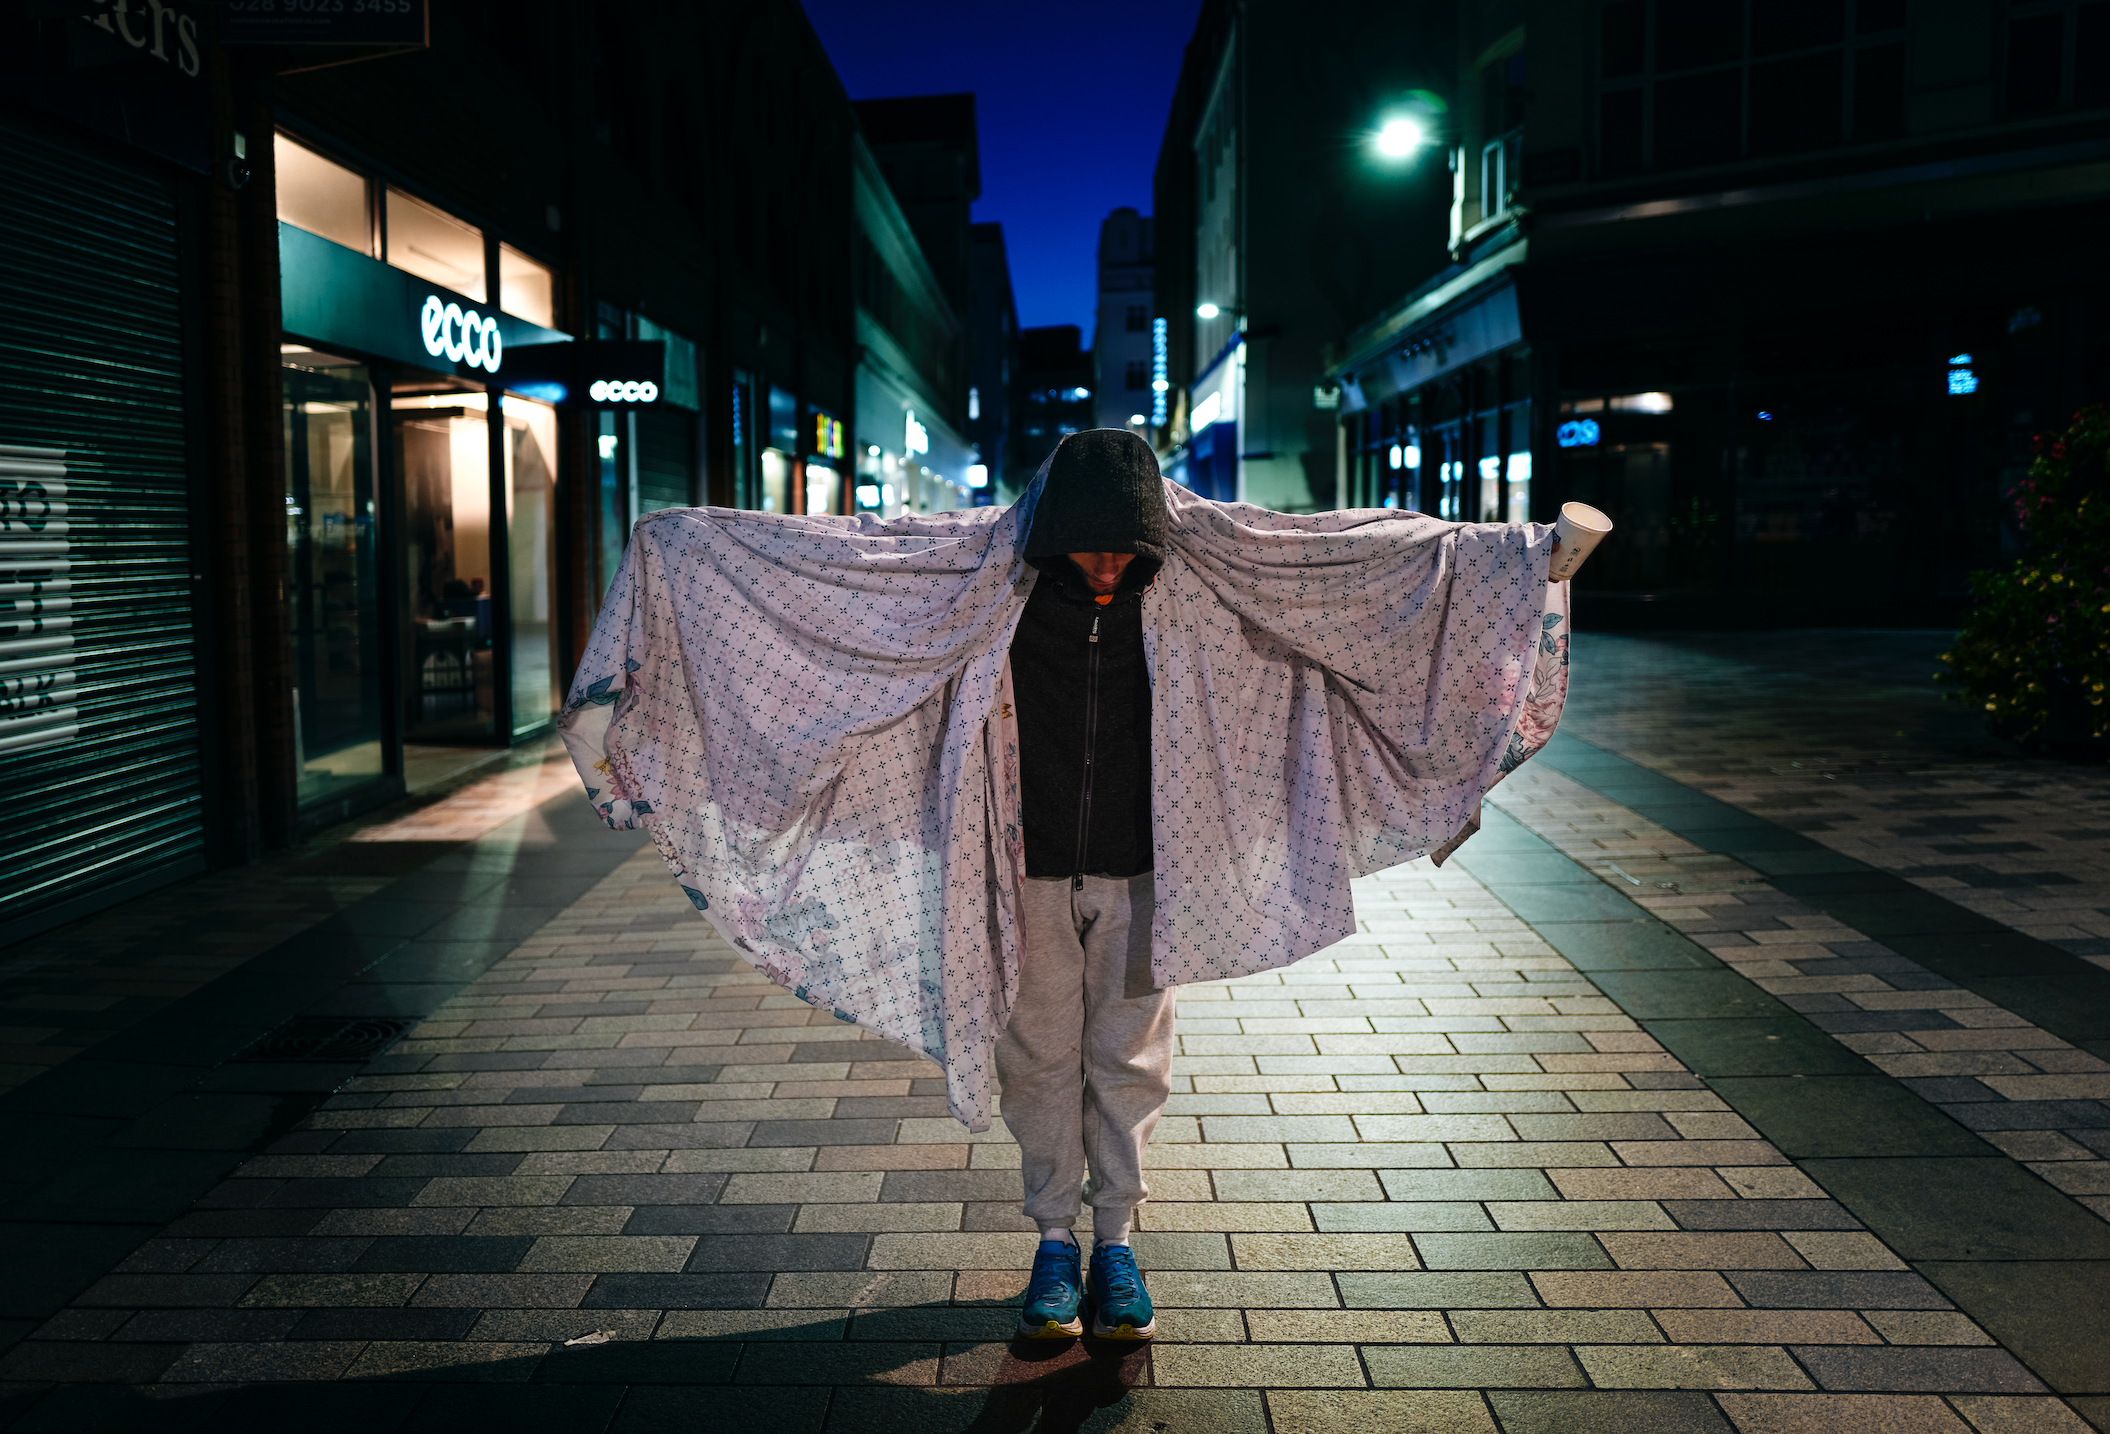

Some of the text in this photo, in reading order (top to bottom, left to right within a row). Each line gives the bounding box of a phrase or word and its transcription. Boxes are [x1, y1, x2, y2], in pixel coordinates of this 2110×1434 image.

[229, 0, 412, 14] 028 9023 3455
[421, 294, 503, 374] ecco
[589, 380, 659, 403] ecco
